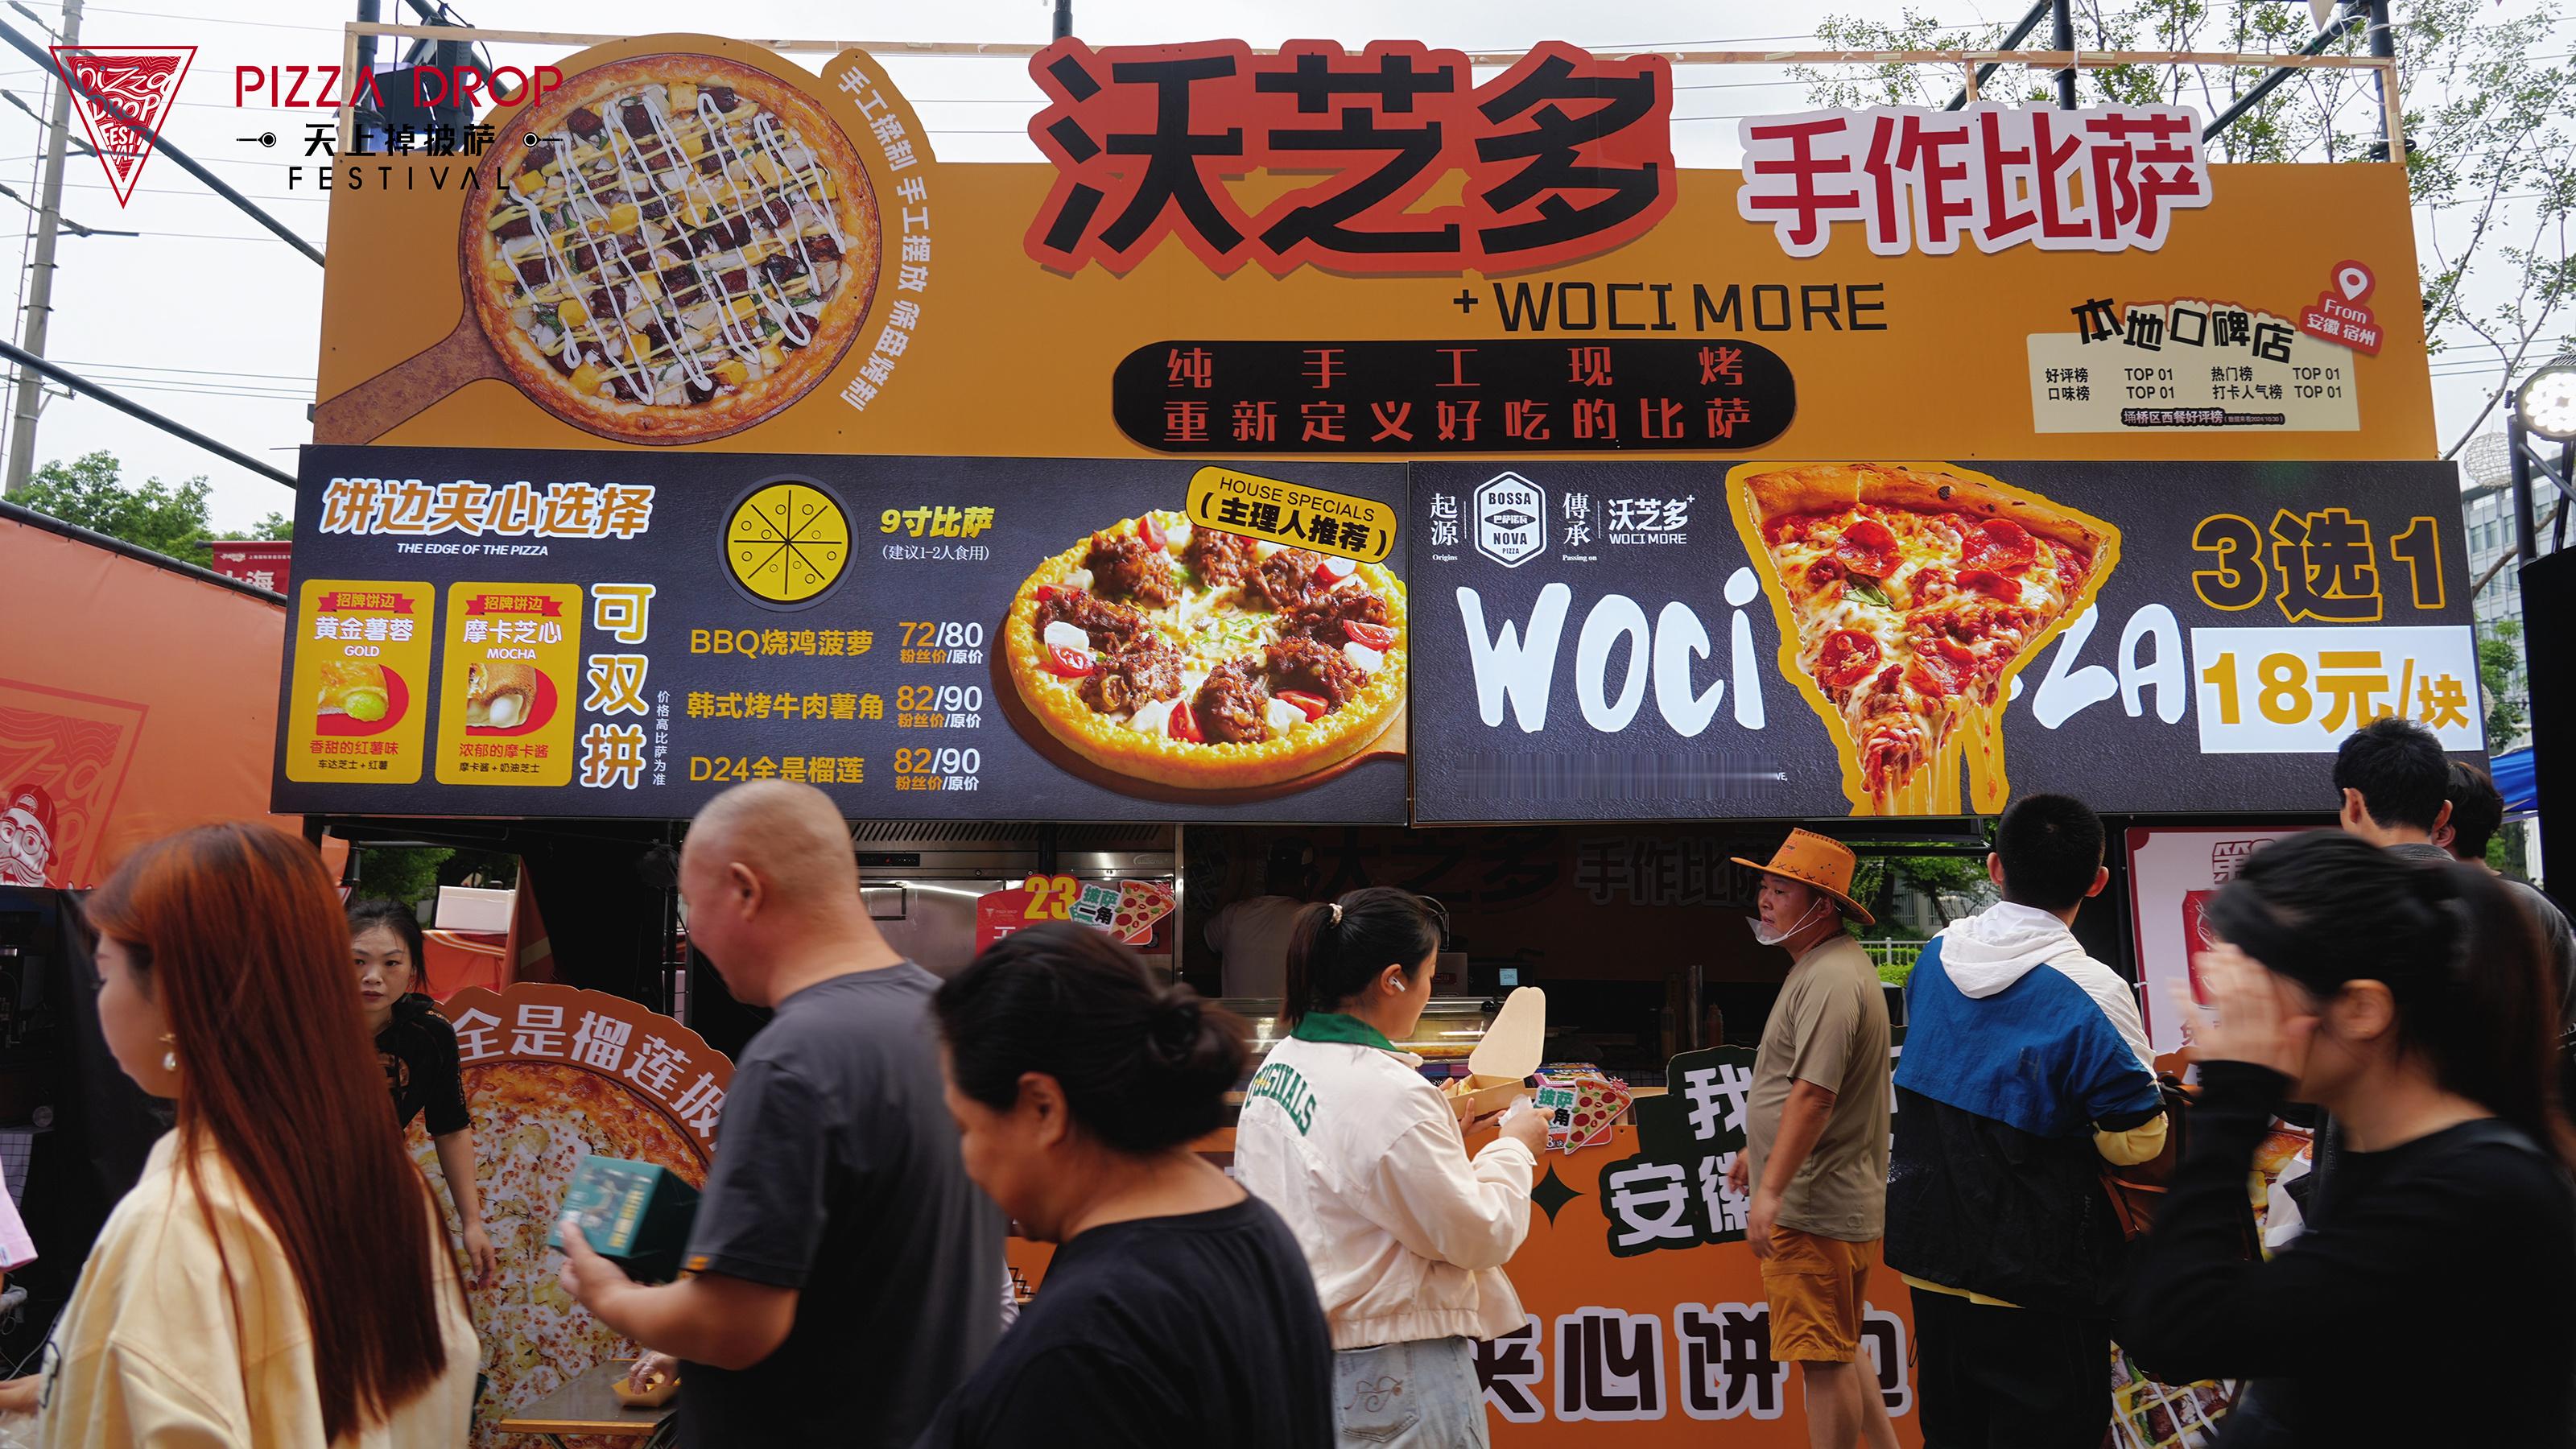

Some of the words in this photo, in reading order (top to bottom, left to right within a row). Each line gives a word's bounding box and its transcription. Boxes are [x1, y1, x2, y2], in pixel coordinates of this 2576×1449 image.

[1043, 53, 1661, 255] 沃芝多
[1749, 112, 2199, 246] 手作比萨
[1492, 282, 1680, 332] WOCI
[1693, 282, 1888, 332] MORE
[2323, 299, 2368, 324] From
[2070, 298, 2295, 364] 本地口碑店
[2045, 367, 2089, 383] 好评榜
[2125, 368, 2154, 382] TOP
[2158, 368, 2174, 381] 01
[2211, 366, 2253, 382] 热门榜
[2293, 368, 2321, 381] TOP
[2325, 368, 2340, 381] 01
[2048, 386, 2090, 402] 口味榜
[2127, 386, 2155, 399] TOP
[2158, 386, 2174, 399] 01
[2213, 385, 2283, 400] 打卡人气榜
[2294, 386, 2322, 399] TOP
[2326, 386, 2343, 399] 01
[1162, 398, 1751, 442] 重新定义好吃的比萨
[322, 479, 655, 539] 饼边夹心选择
[1219, 476, 1283, 503] HOUSE
[1287, 491, 1375, 522] SPECIALS
[1488, 492, 1531, 506] BOSSA
[880, 506, 995, 539] 9寸比萨
[397, 543, 423, 554] THE
[425, 544, 460, 554] EDGE
[462, 544, 481, 555] OF
[483, 545, 509, 555] THE
[510, 546, 548, 555] PIZZA
[1493, 532, 1528, 545] NOVA
[1648, 533, 1687, 544] MORE
[1432, 553, 1458, 563] Origins
[1563, 554, 1586, 563] Passing
[2192, 507, 2445, 623] 3选1
[336, 593, 395, 609] 招牌饼边
[484, 596, 543, 611] 招牌饼边
[313, 617, 414, 642] 黄金薯蓉
[463, 619, 563, 645] 摩卡芝心
[898, 621, 984, 648] 72/80
[344, 645, 380, 658] GOLD
[487, 647, 537, 660] MOCHA
[690, 629, 873, 660] BBQ烧鸡菠萝
[900, 649, 984, 665] 粉丝价/原价
[580, 583, 656, 791] 可双拼
[896, 685, 983, 712] 82/90
[687, 691, 884, 720] 韩式烤牛肉薯角
[898, 713, 981, 729] 粉丝价/原价
[309, 741, 399, 755] 香甜的红薯味
[460, 743, 549, 759] 浓郁的摩卡酱
[652, 690, 671, 786] 价格高比萨为准
[689, 756, 865, 784] D24全是榴莲
[894, 747, 980, 774] 82/90
[895, 776, 980, 791] 粉丝价/原价
[1023, 876, 1078, 920] 23
[453, 1003, 729, 1151] 全是榴莲披
